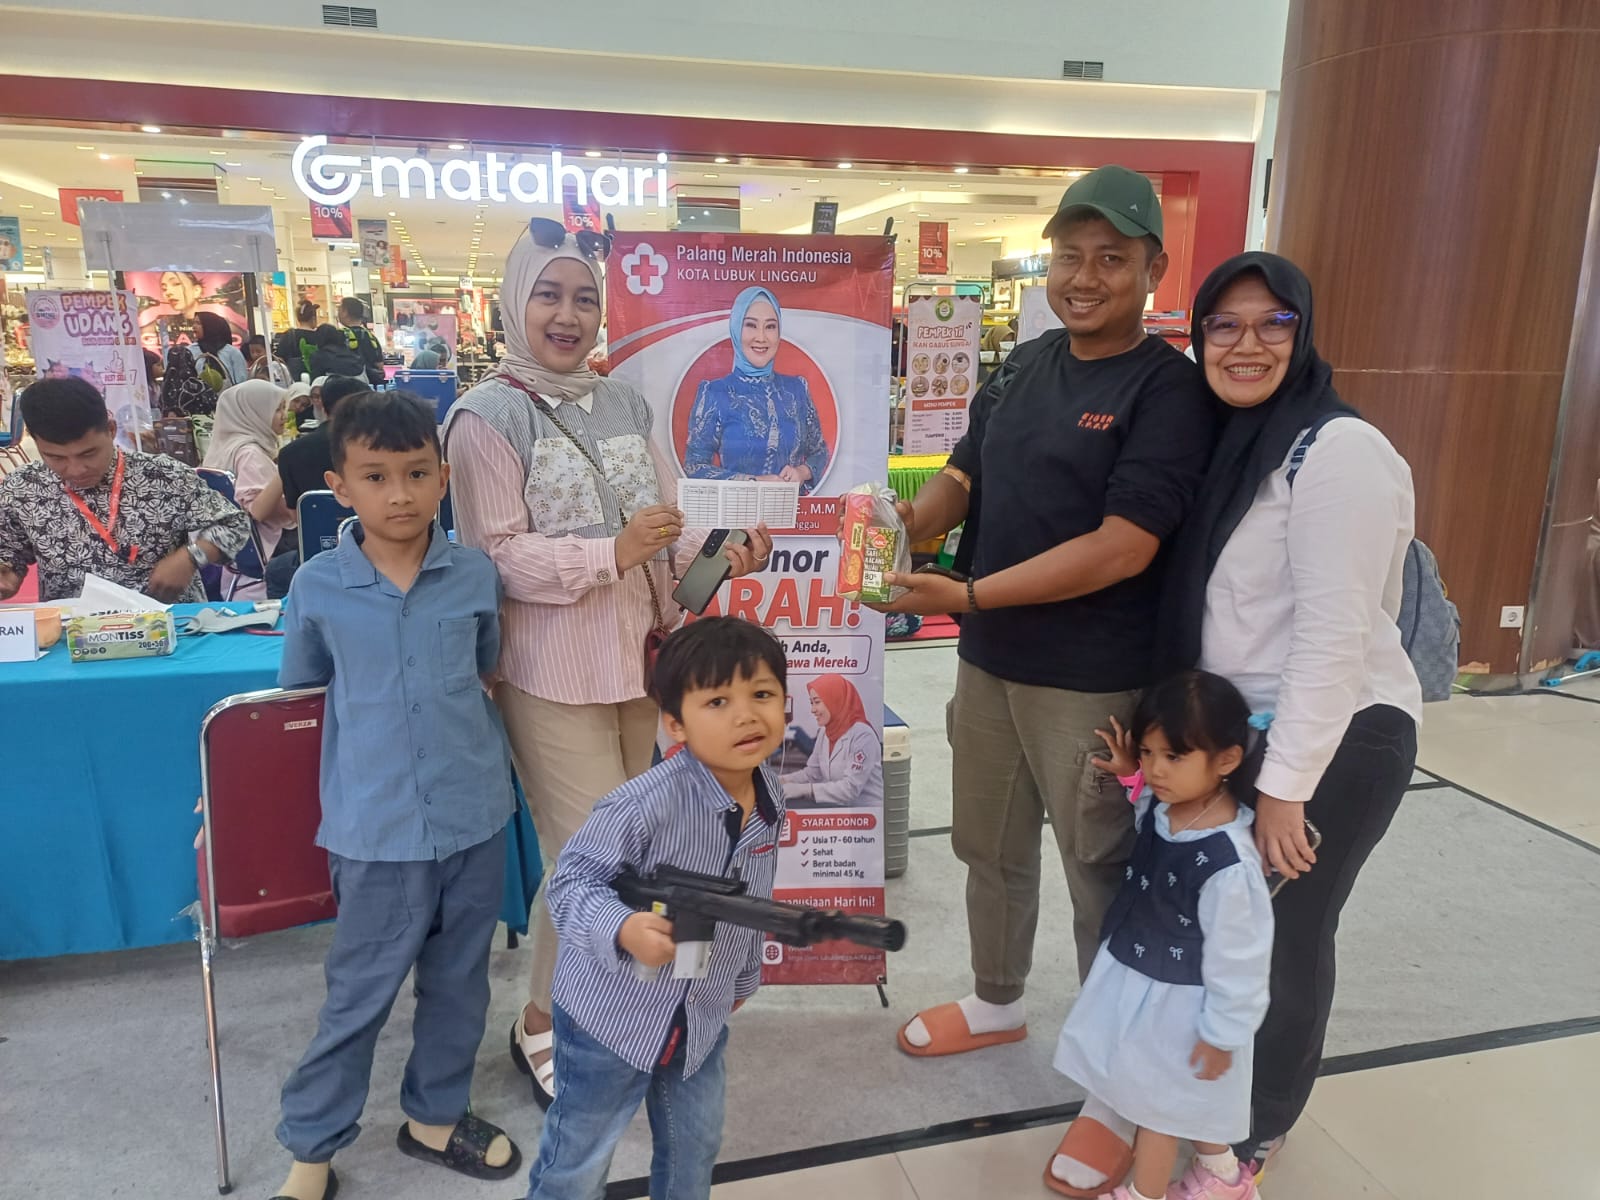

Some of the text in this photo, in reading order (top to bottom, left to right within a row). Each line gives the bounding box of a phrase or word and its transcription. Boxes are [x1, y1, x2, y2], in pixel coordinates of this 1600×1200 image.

[371, 150, 668, 207] matahari
[677, 246, 851, 264] Palang Merah Indonesia
[677, 268, 817, 283] KOTA LUBUK LINGGAU
[918, 326, 953, 338] PEMPEK
[810, 503, 836, 514] M.M
[760, 550, 829, 573] nor
[88, 630, 144, 642] MONTISS
[792, 640, 830, 655] Anda,
[786, 656, 858, 668] awa Mereka
[802, 817, 869, 827] SYARAT DONOR
[813, 836, 828, 844] Usia
[854, 836, 875, 844] tahun
[813, 848, 833, 856] Sehat
[813, 859, 856, 868] Berat badan
[813, 870, 842, 878] minimal
[855, 870, 865, 879] Kg
[834, 896, 856, 907] Hari
[859, 896, 875, 907] Ini!
